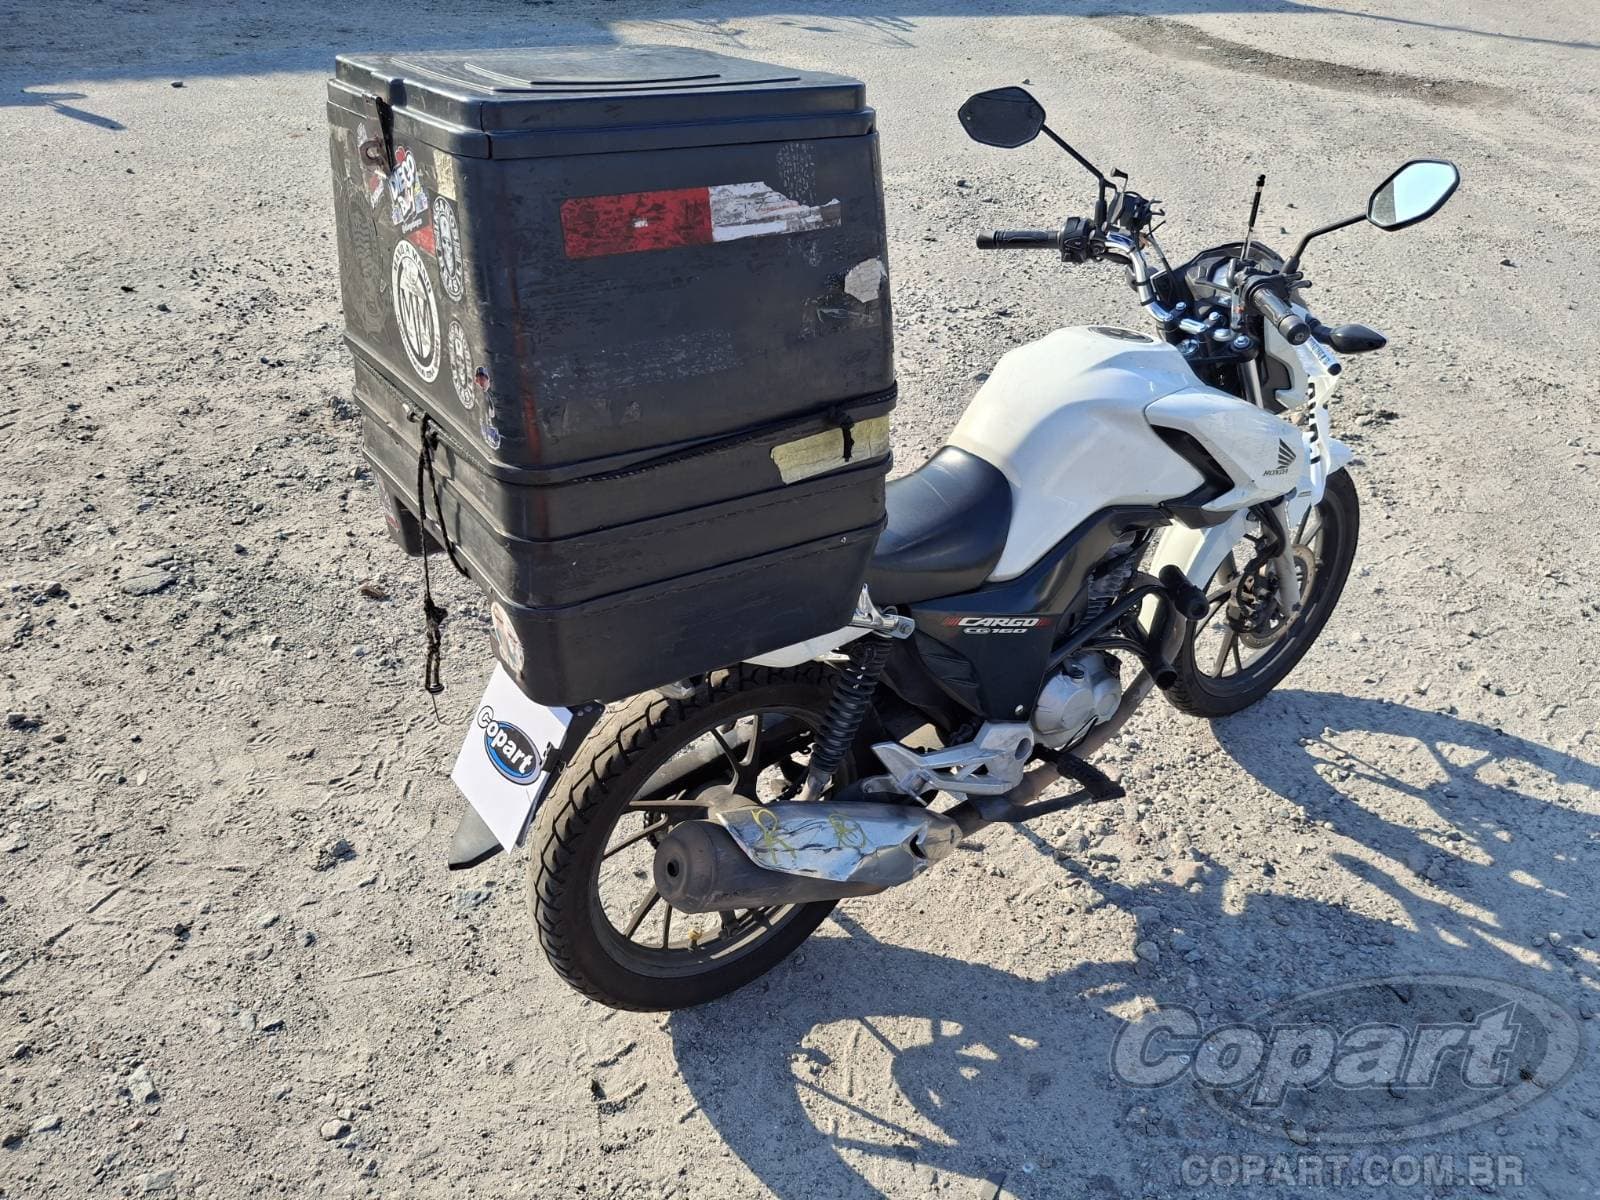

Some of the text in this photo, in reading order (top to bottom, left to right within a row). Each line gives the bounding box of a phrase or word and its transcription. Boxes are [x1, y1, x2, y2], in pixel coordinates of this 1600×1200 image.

[389, 151, 415, 200] DIEGO
[958, 617, 1040, 627] CARGO
[477, 705, 536, 775] Copart
